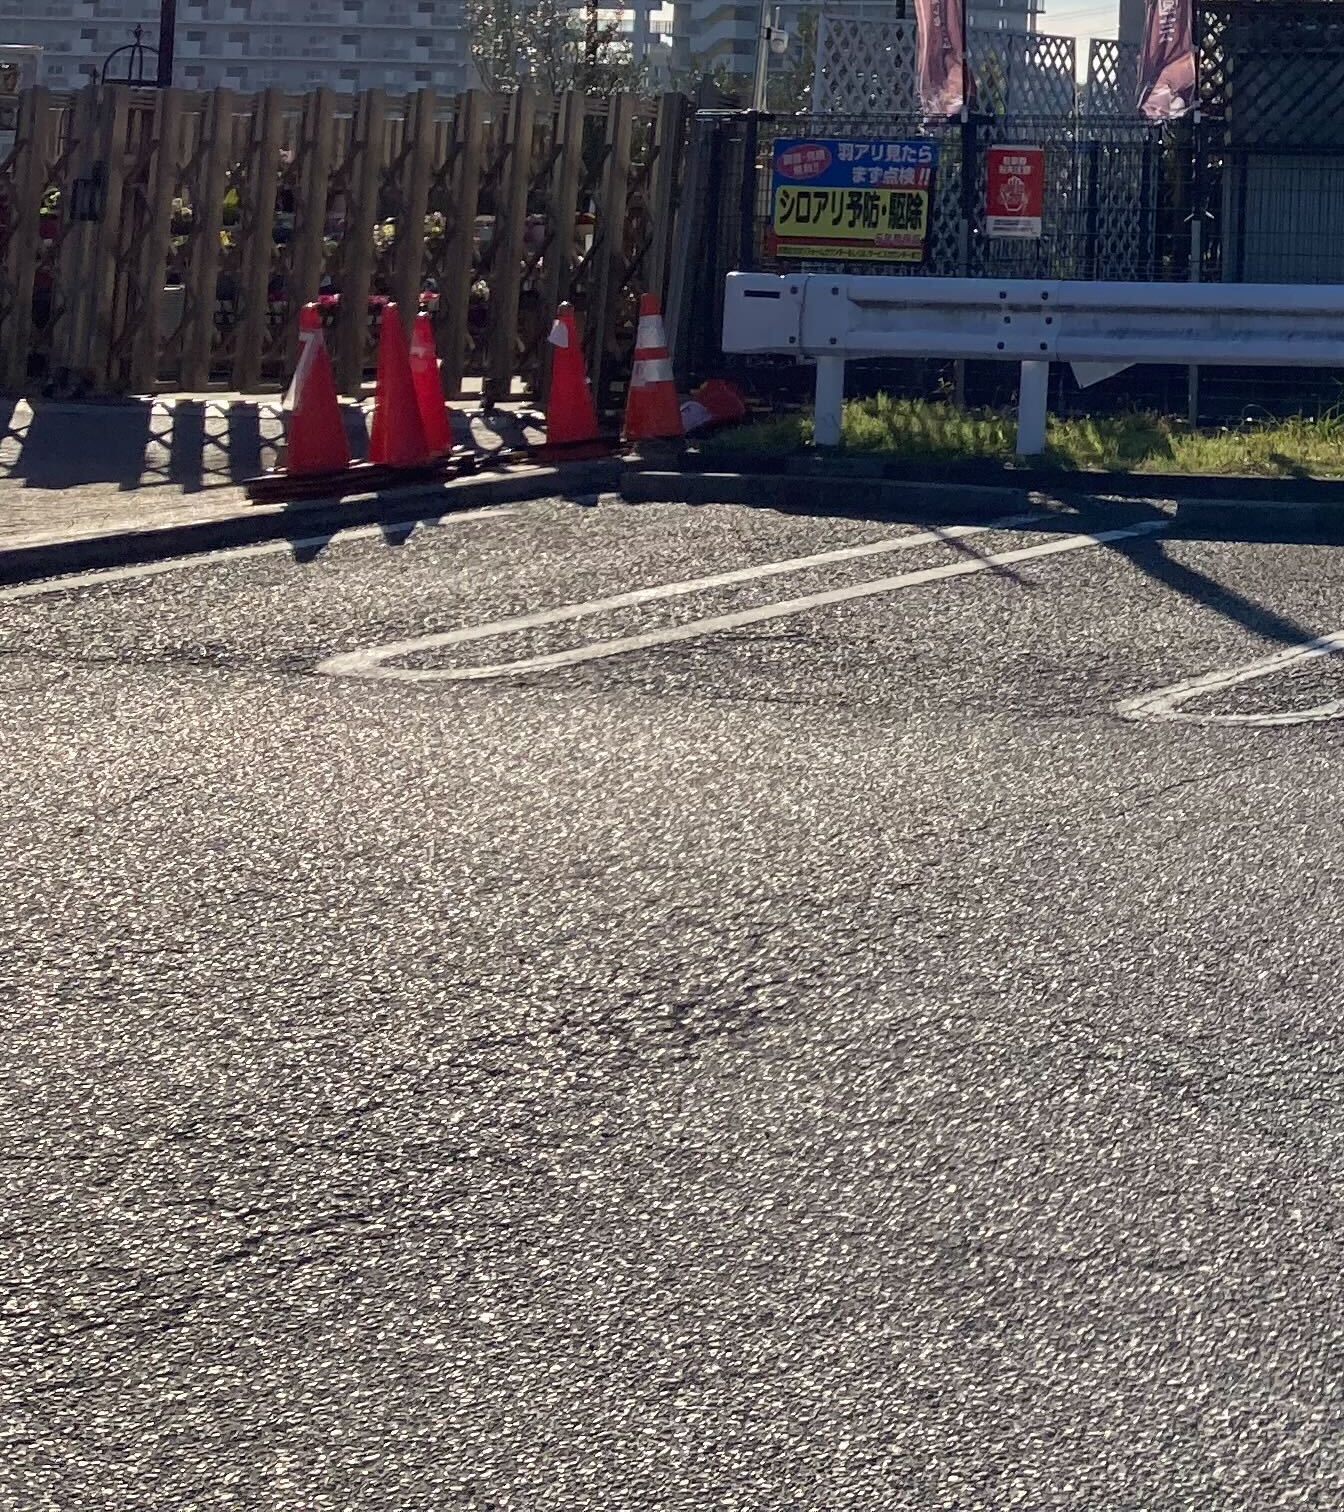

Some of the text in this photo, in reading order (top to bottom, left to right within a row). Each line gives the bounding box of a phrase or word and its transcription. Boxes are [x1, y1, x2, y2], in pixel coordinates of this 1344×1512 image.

[838, 142, 933, 163] 羽アリ見たら
[780, 190, 923, 230] シロアリ予防・駆除
